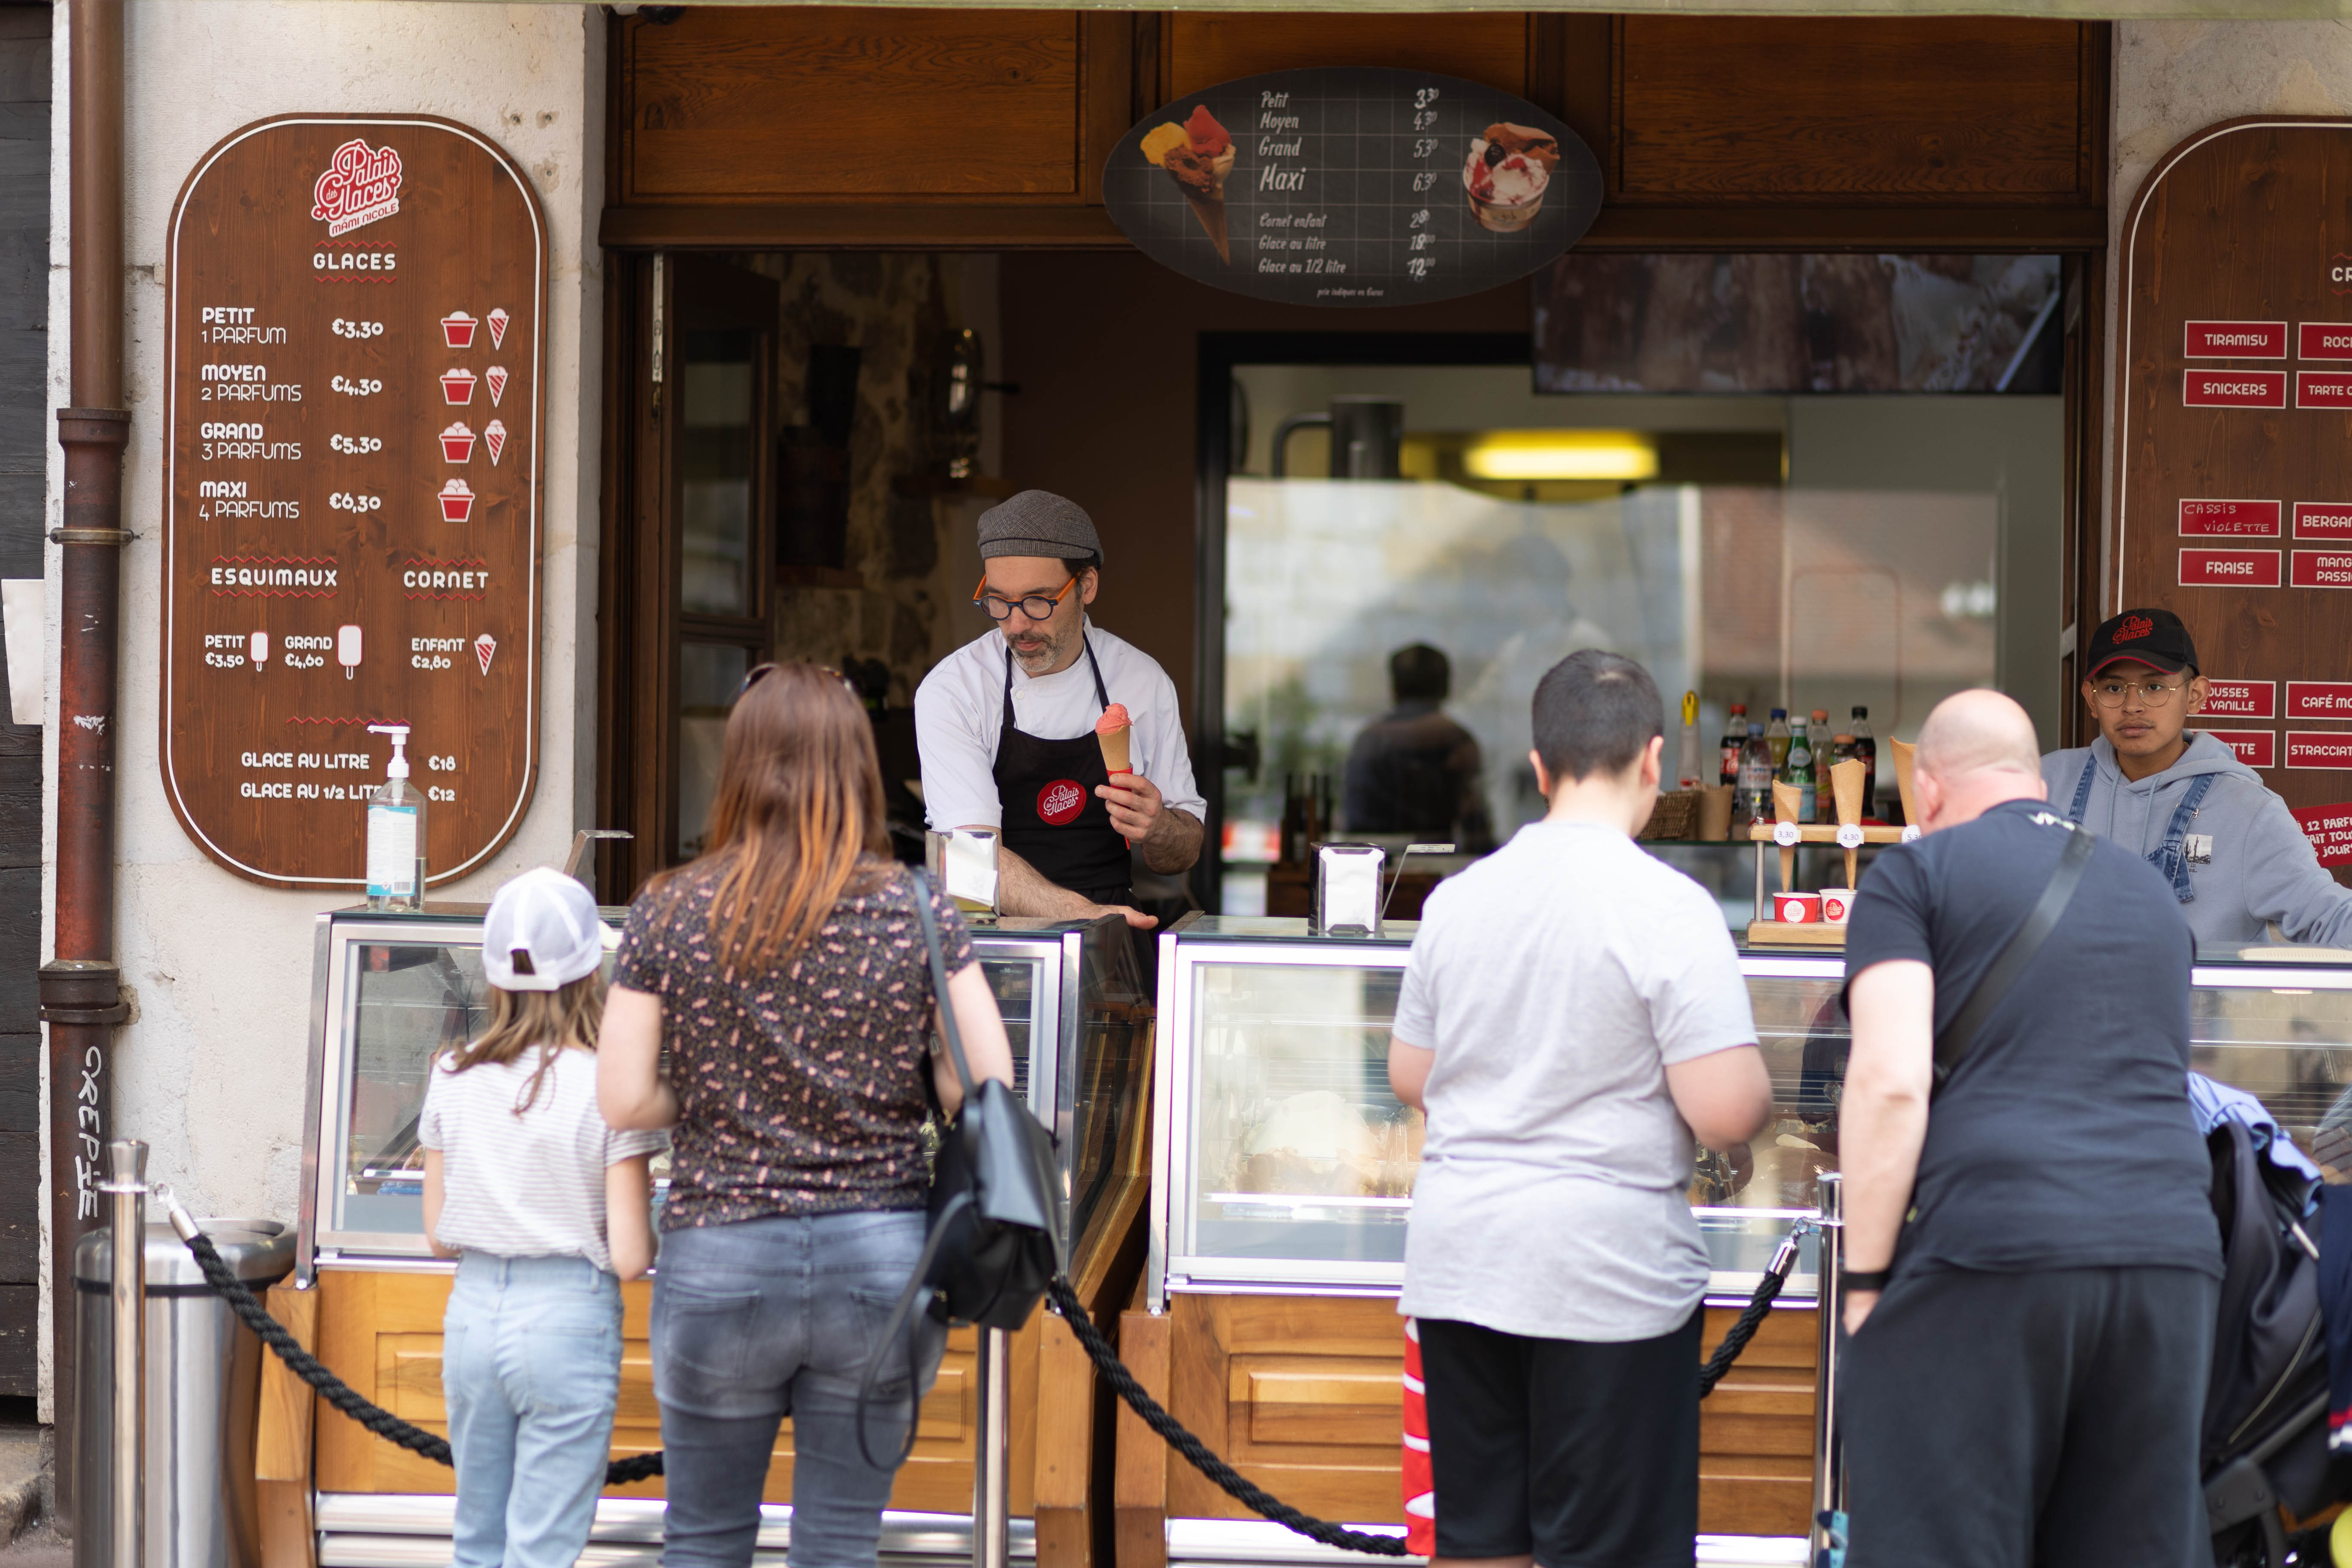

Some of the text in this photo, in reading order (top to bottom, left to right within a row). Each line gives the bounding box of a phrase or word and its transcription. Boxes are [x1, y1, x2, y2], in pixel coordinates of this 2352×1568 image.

[1261, 91, 1289, 108] Petit
[1260, 111, 1299, 135] Moyen
[1259, 135, 1302, 156] Grand
[337, 144, 397, 187] Palais
[1259, 163, 1307, 192] Maxi
[319, 173, 392, 218] des Glaces
[332, 203, 397, 235] MAMI NICOLE
[1260, 212, 1292, 228] Cornet
[1294, 212, 1327, 229] enfant
[1259, 235, 1286, 250] Glace
[1290, 240, 1302, 250] au
[1305, 235, 1326, 250] litre
[313, 253, 396, 270] GLACES
[1259, 258, 1286, 273] Glace
[1289, 263, 1302, 273] au
[1305, 258, 1323, 273] 1/2
[1325, 259, 1346, 273] litre
[202, 307, 255, 325] PETIT
[201, 330, 207, 343] 1
[213, 327, 286, 344] PARFUM
[2204, 334, 2268, 346] TIRAMISU
[2323, 336, 2352, 348] ROC
[202, 364, 266, 381] MOYEN
[201, 387, 211, 401] 2
[217, 384, 302, 401] PARFUMS
[2203, 382, 2267, 395] SNICKERS
[2308, 385, 2344, 395] TARTE
[201, 422, 263, 440] GRAND
[202, 443, 213, 460] 3
[217, 442, 301, 460] PARFUMS
[200, 481, 247, 498] MAXI
[199, 504, 210, 521] 4
[215, 500, 299, 518] PARFUMS
[2206, 561, 2254, 575] FRAISE
[2317, 557, 2352, 568] MANG
[211, 568, 337, 587] ESQUIMAUX
[404, 570, 489, 588] CORNET
[2317, 571, 2352, 582] PASSI
[2122, 615, 2153, 631] Palais
[205, 634, 245, 649] PETIT
[285, 636, 333, 650] GRAND
[411, 637, 466, 652] ENFANT
[2208, 687, 2249, 698] OUSSES
[2302, 694, 2333, 708] CAFÉ
[2210, 700, 2255, 711] VANILLE
[241, 752, 456, 771] GLACE AU LITRE €18
[241, 782, 455, 802] GLACE AU 1/2 LIT €12
[1052, 785, 1079, 801] Palais
[1044, 796, 1076, 816] Glaces
[2306, 821, 2320, 832] 12
[2306, 833, 2325, 844] AiT
[2329, 831, 2352, 842] TOU
[2322, 844, 2352, 858] jOUR
